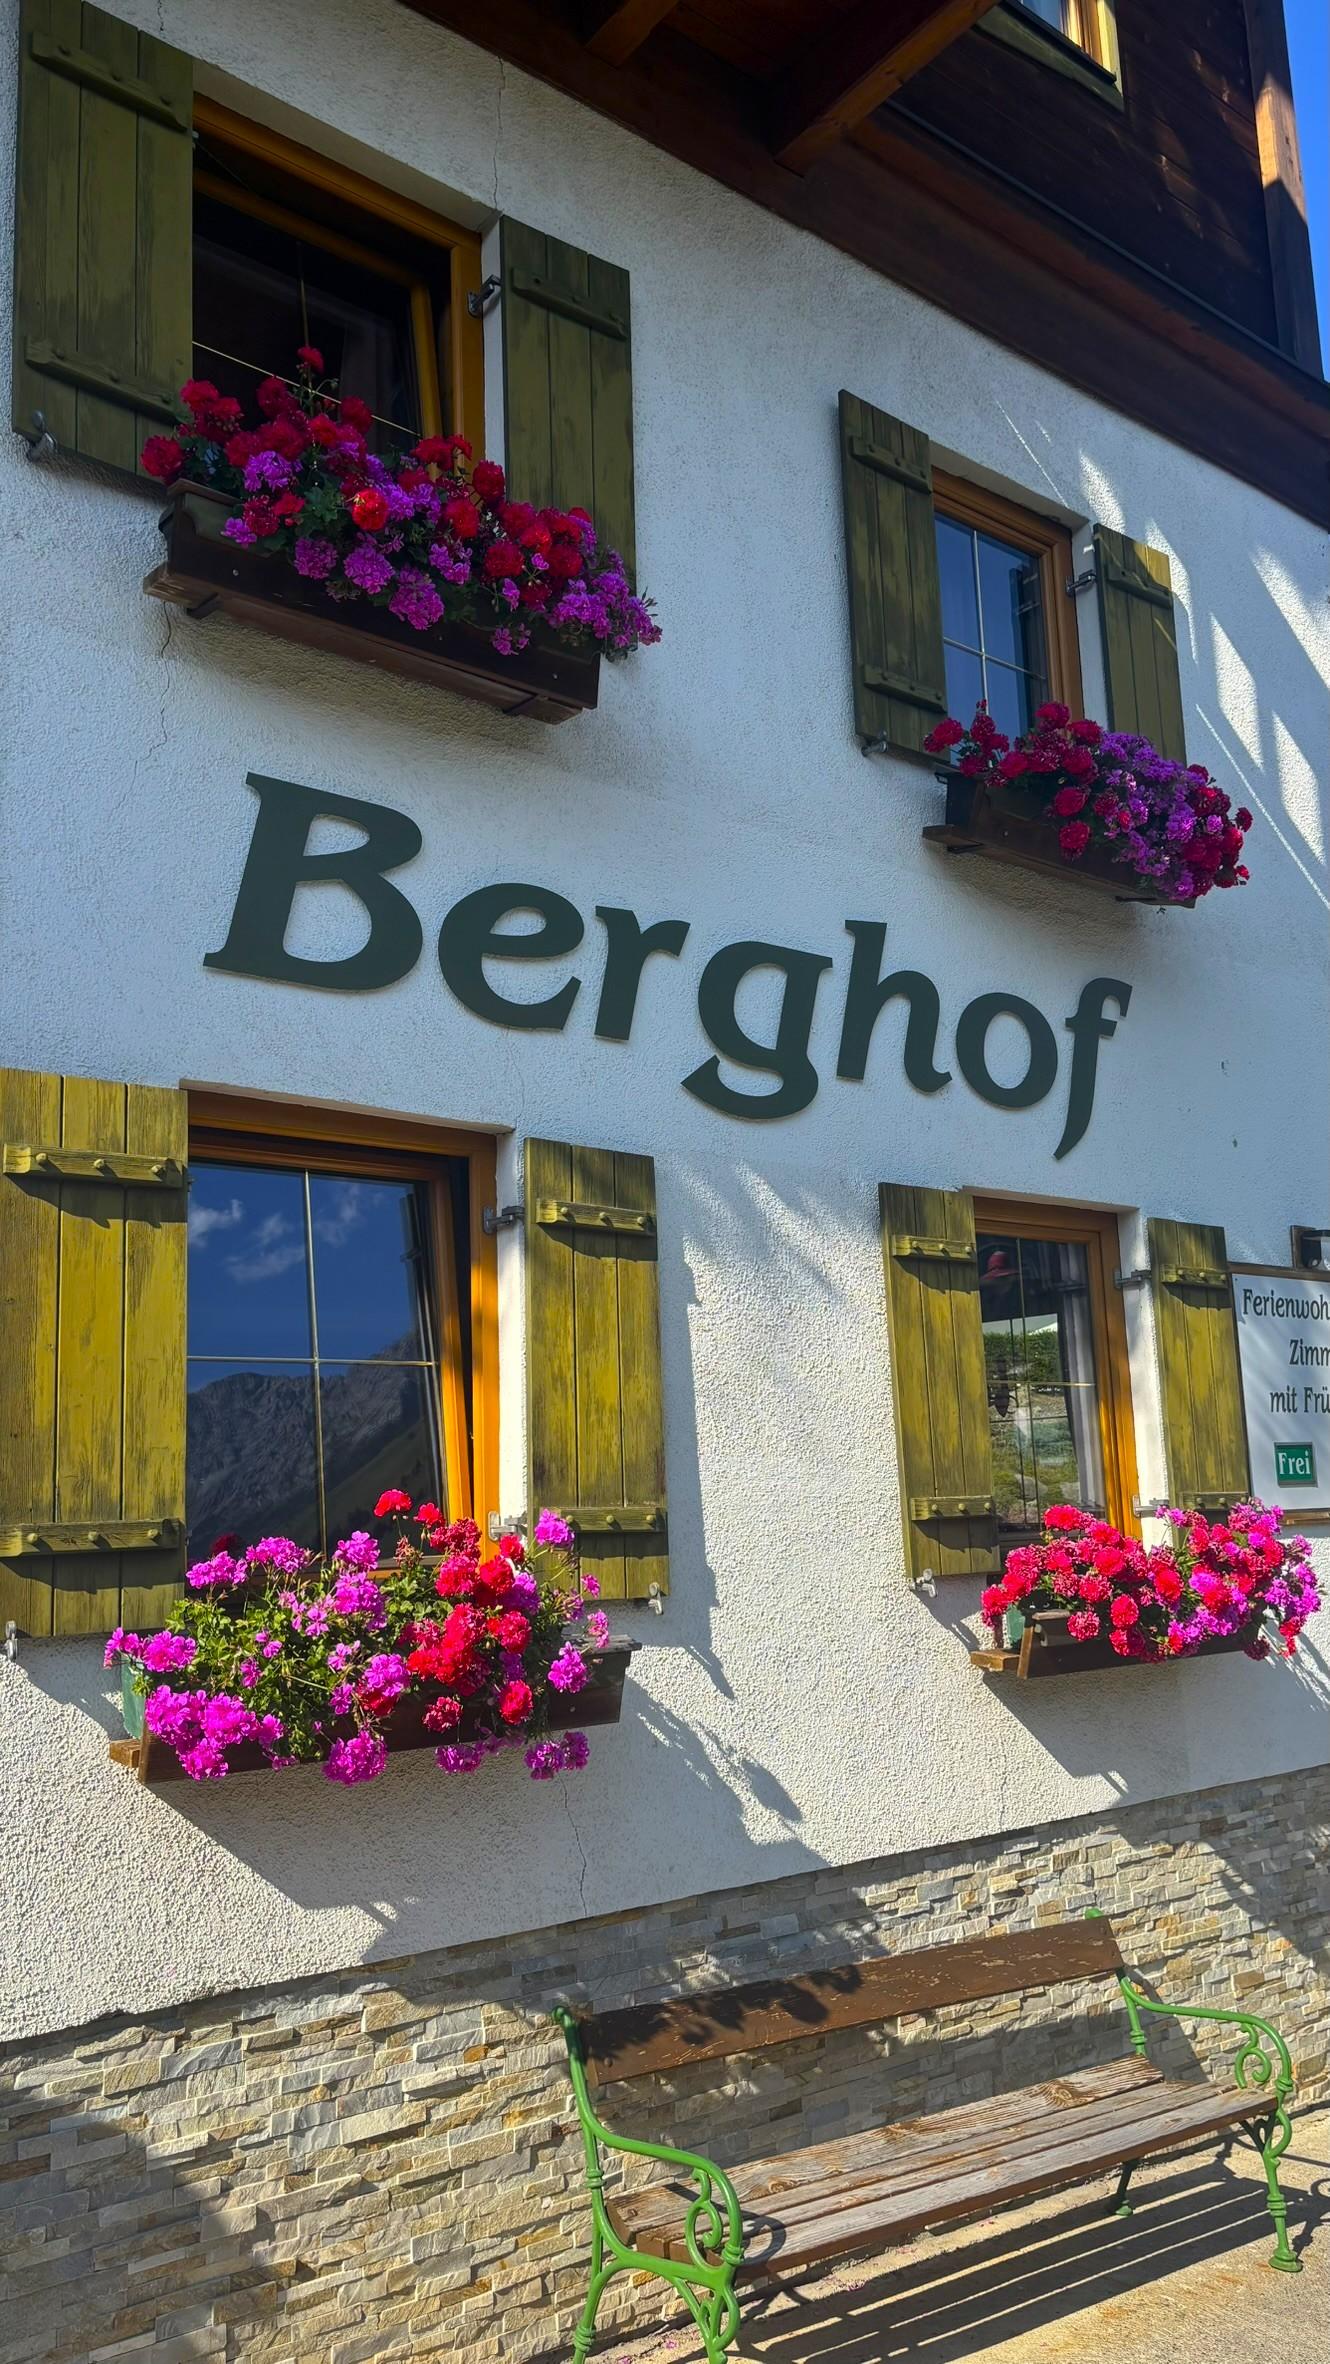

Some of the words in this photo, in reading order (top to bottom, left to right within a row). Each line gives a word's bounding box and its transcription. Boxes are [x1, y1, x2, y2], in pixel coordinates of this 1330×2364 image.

[203, 771, 1132, 1160] Berghof
[1242, 1288, 1330, 1320] Ferienwoh
[1269, 1385, 1298, 1413] mit
[1277, 1451, 1311, 1476] Frei
